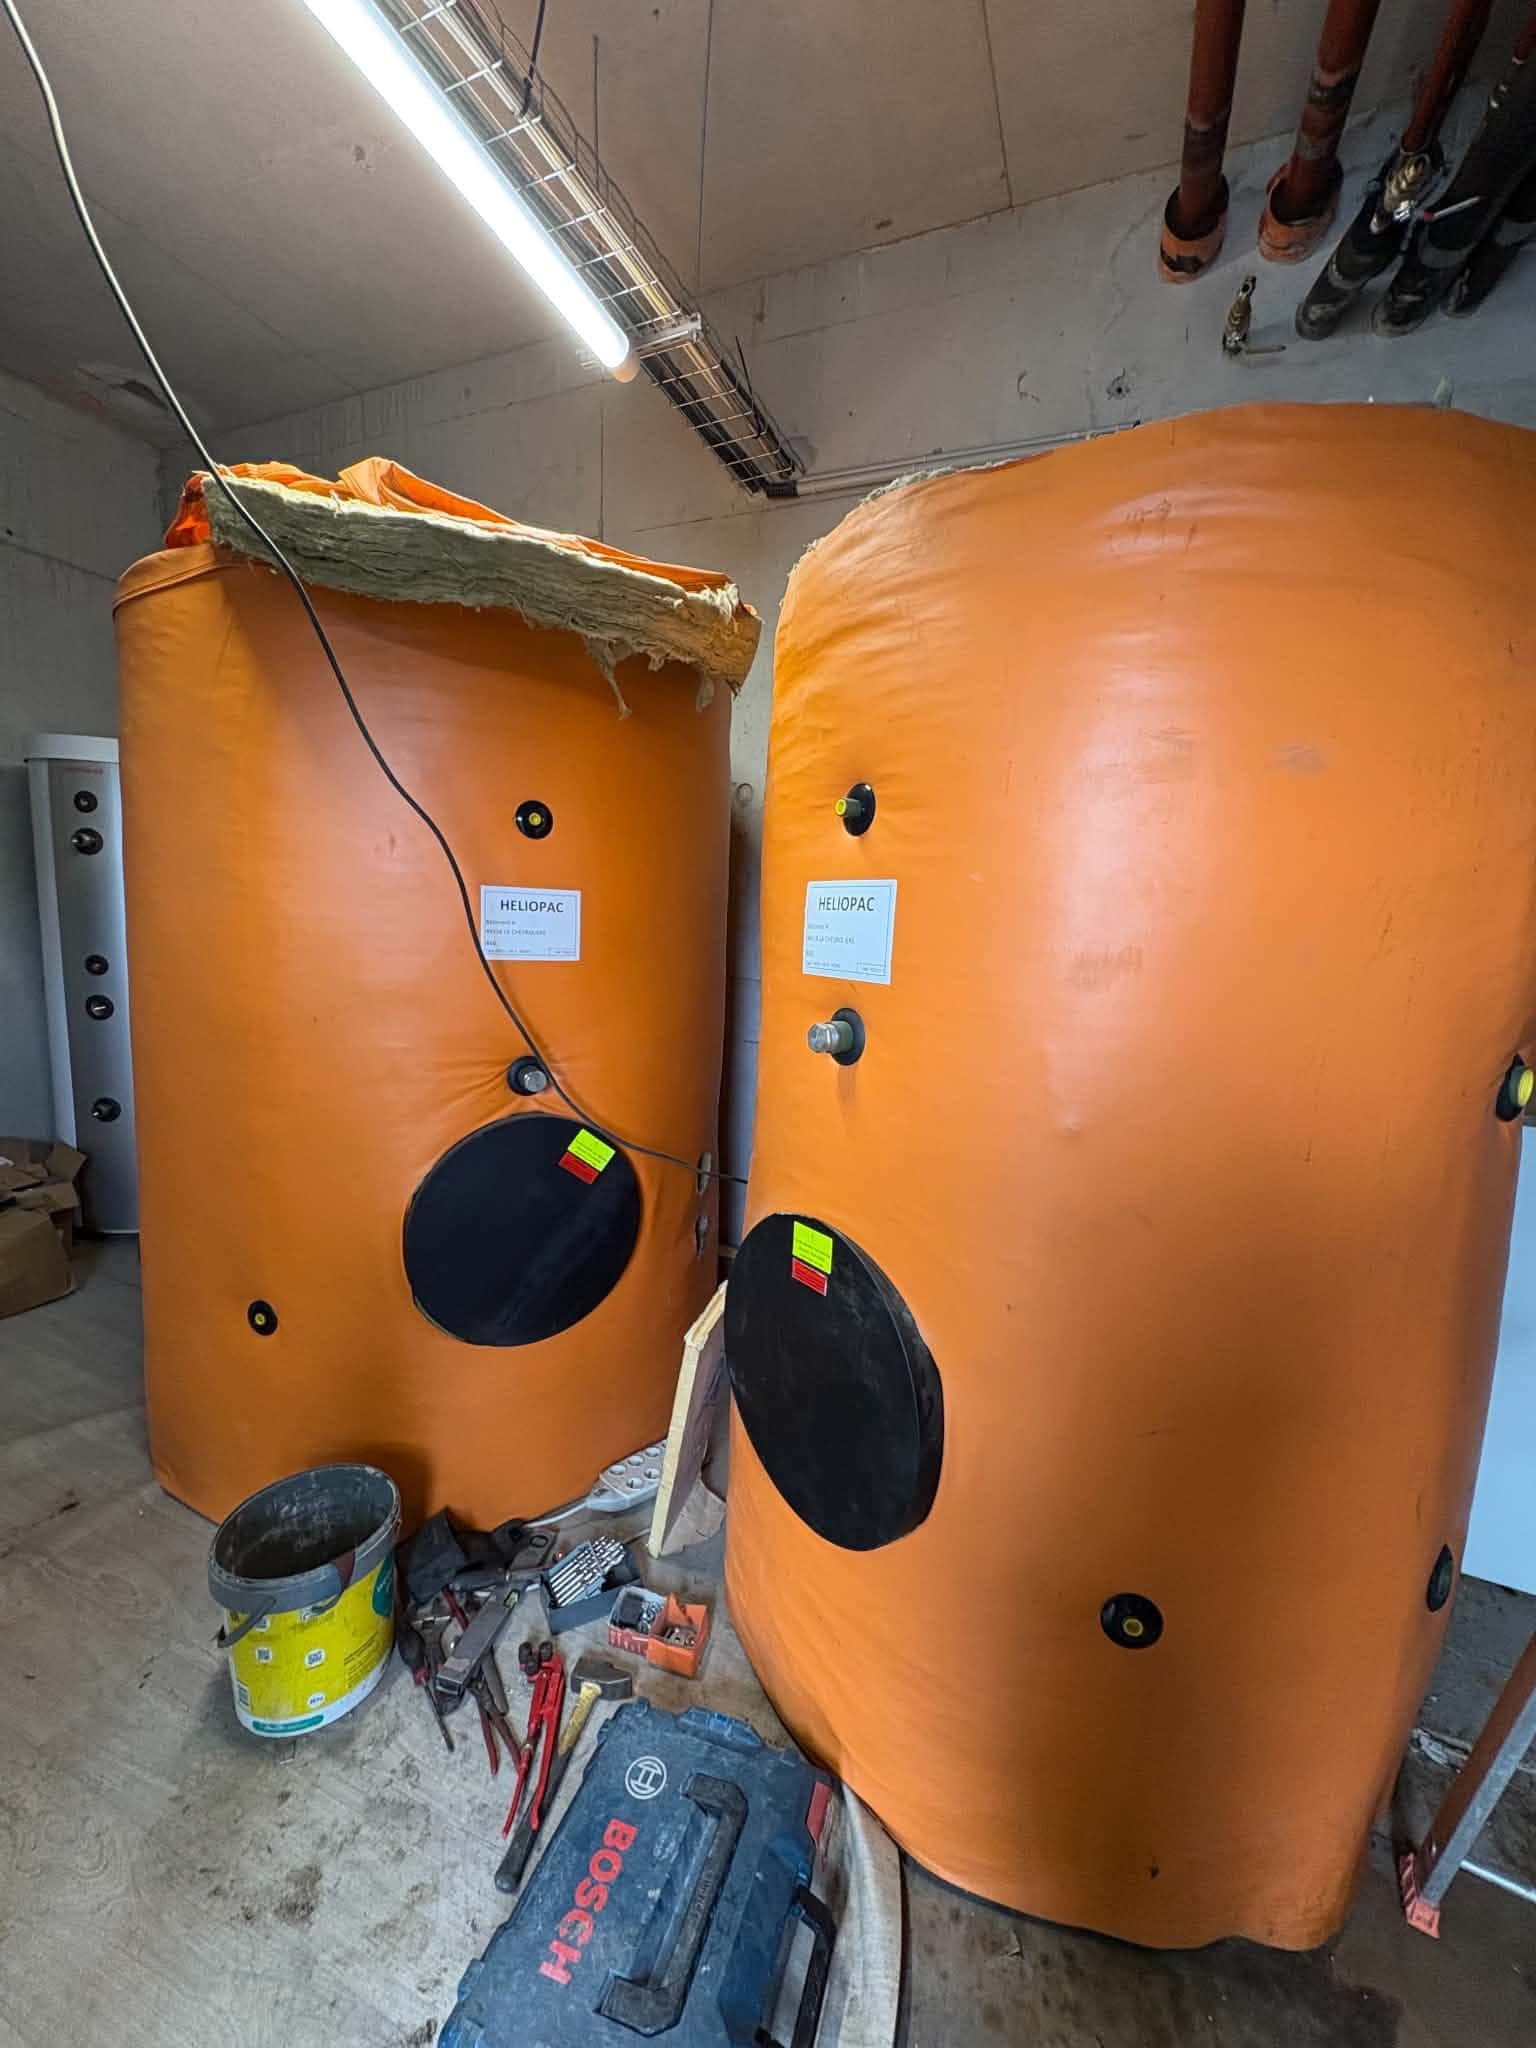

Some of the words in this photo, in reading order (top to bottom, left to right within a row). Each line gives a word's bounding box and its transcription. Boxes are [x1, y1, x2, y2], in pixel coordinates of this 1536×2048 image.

[500, 899, 564, 913] HELIOPAC
[818, 896, 875, 912] HELIOPAC
[538, 1817, 638, 1985] BOSCH
